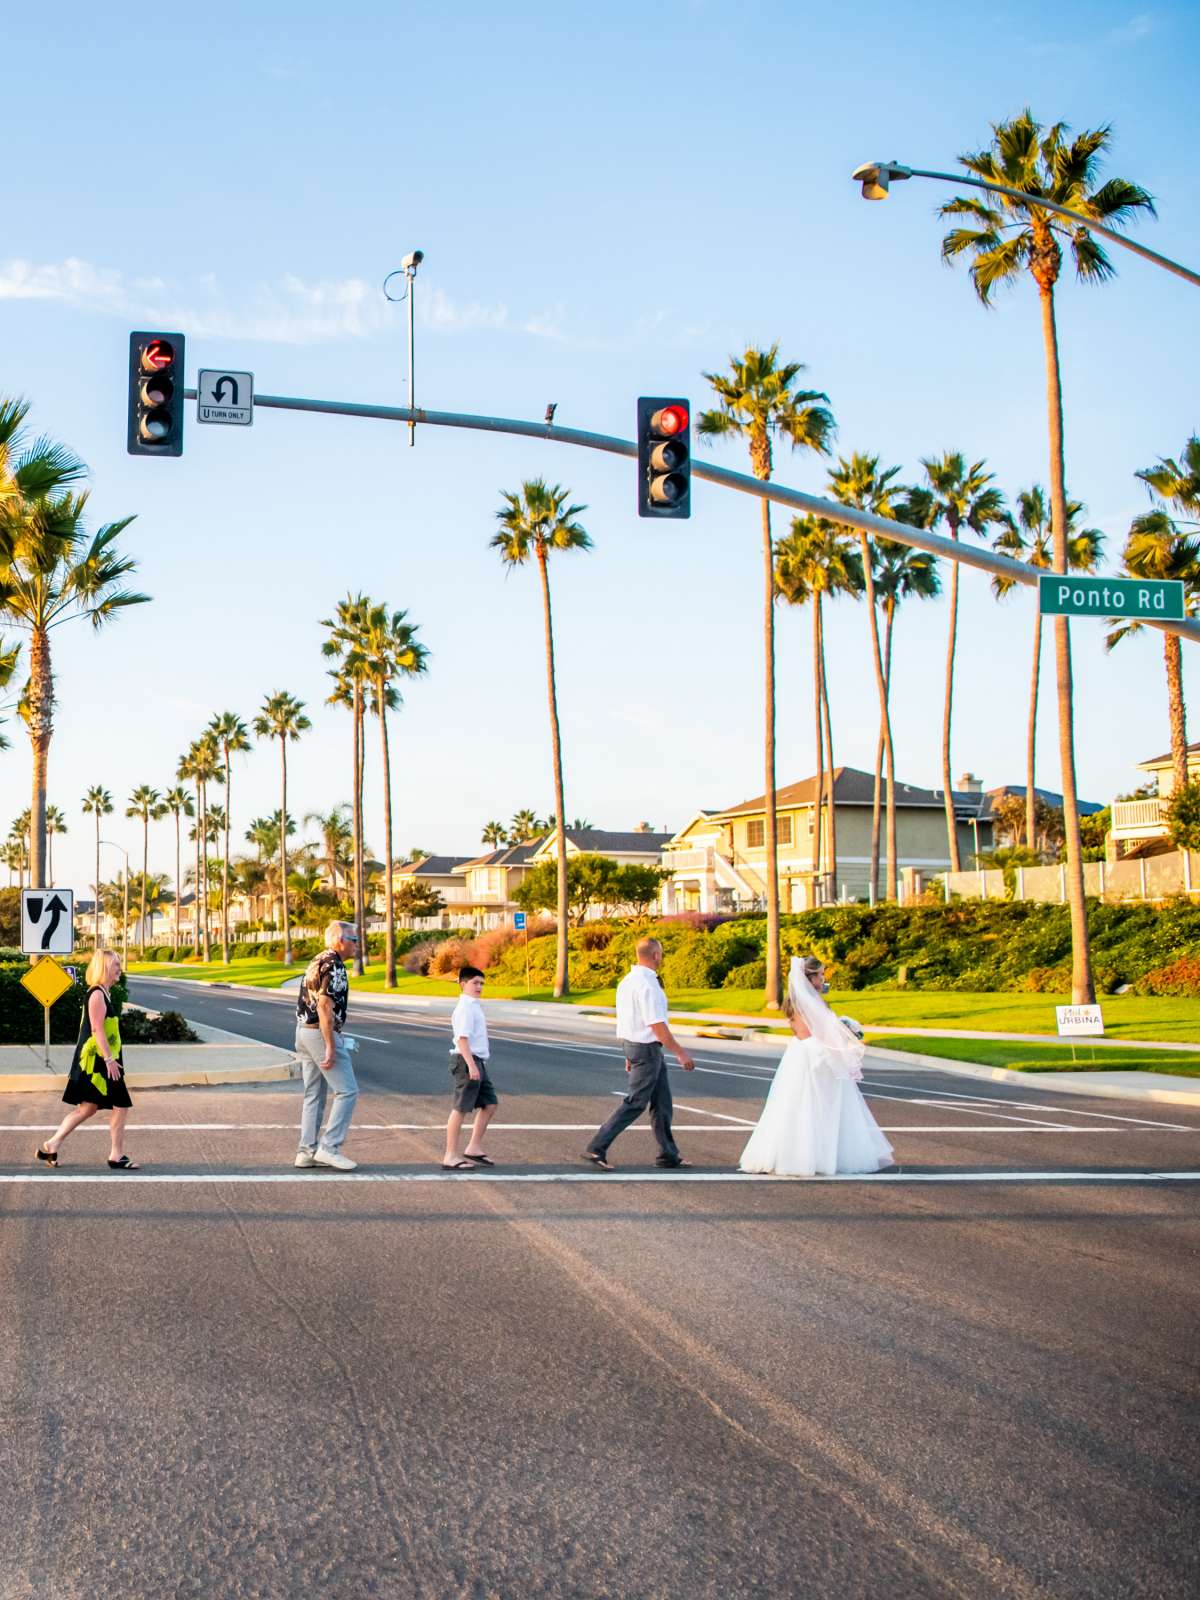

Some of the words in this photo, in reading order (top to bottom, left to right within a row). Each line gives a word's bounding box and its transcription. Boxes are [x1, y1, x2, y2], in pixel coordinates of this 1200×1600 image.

[203, 409, 210, 418] U
[228, 411, 244, 419] ONLY
[1058, 585, 1126, 608] Ponto
[1138, 588, 1165, 609] Rd
[1059, 1016, 1100, 1024] URBINA
